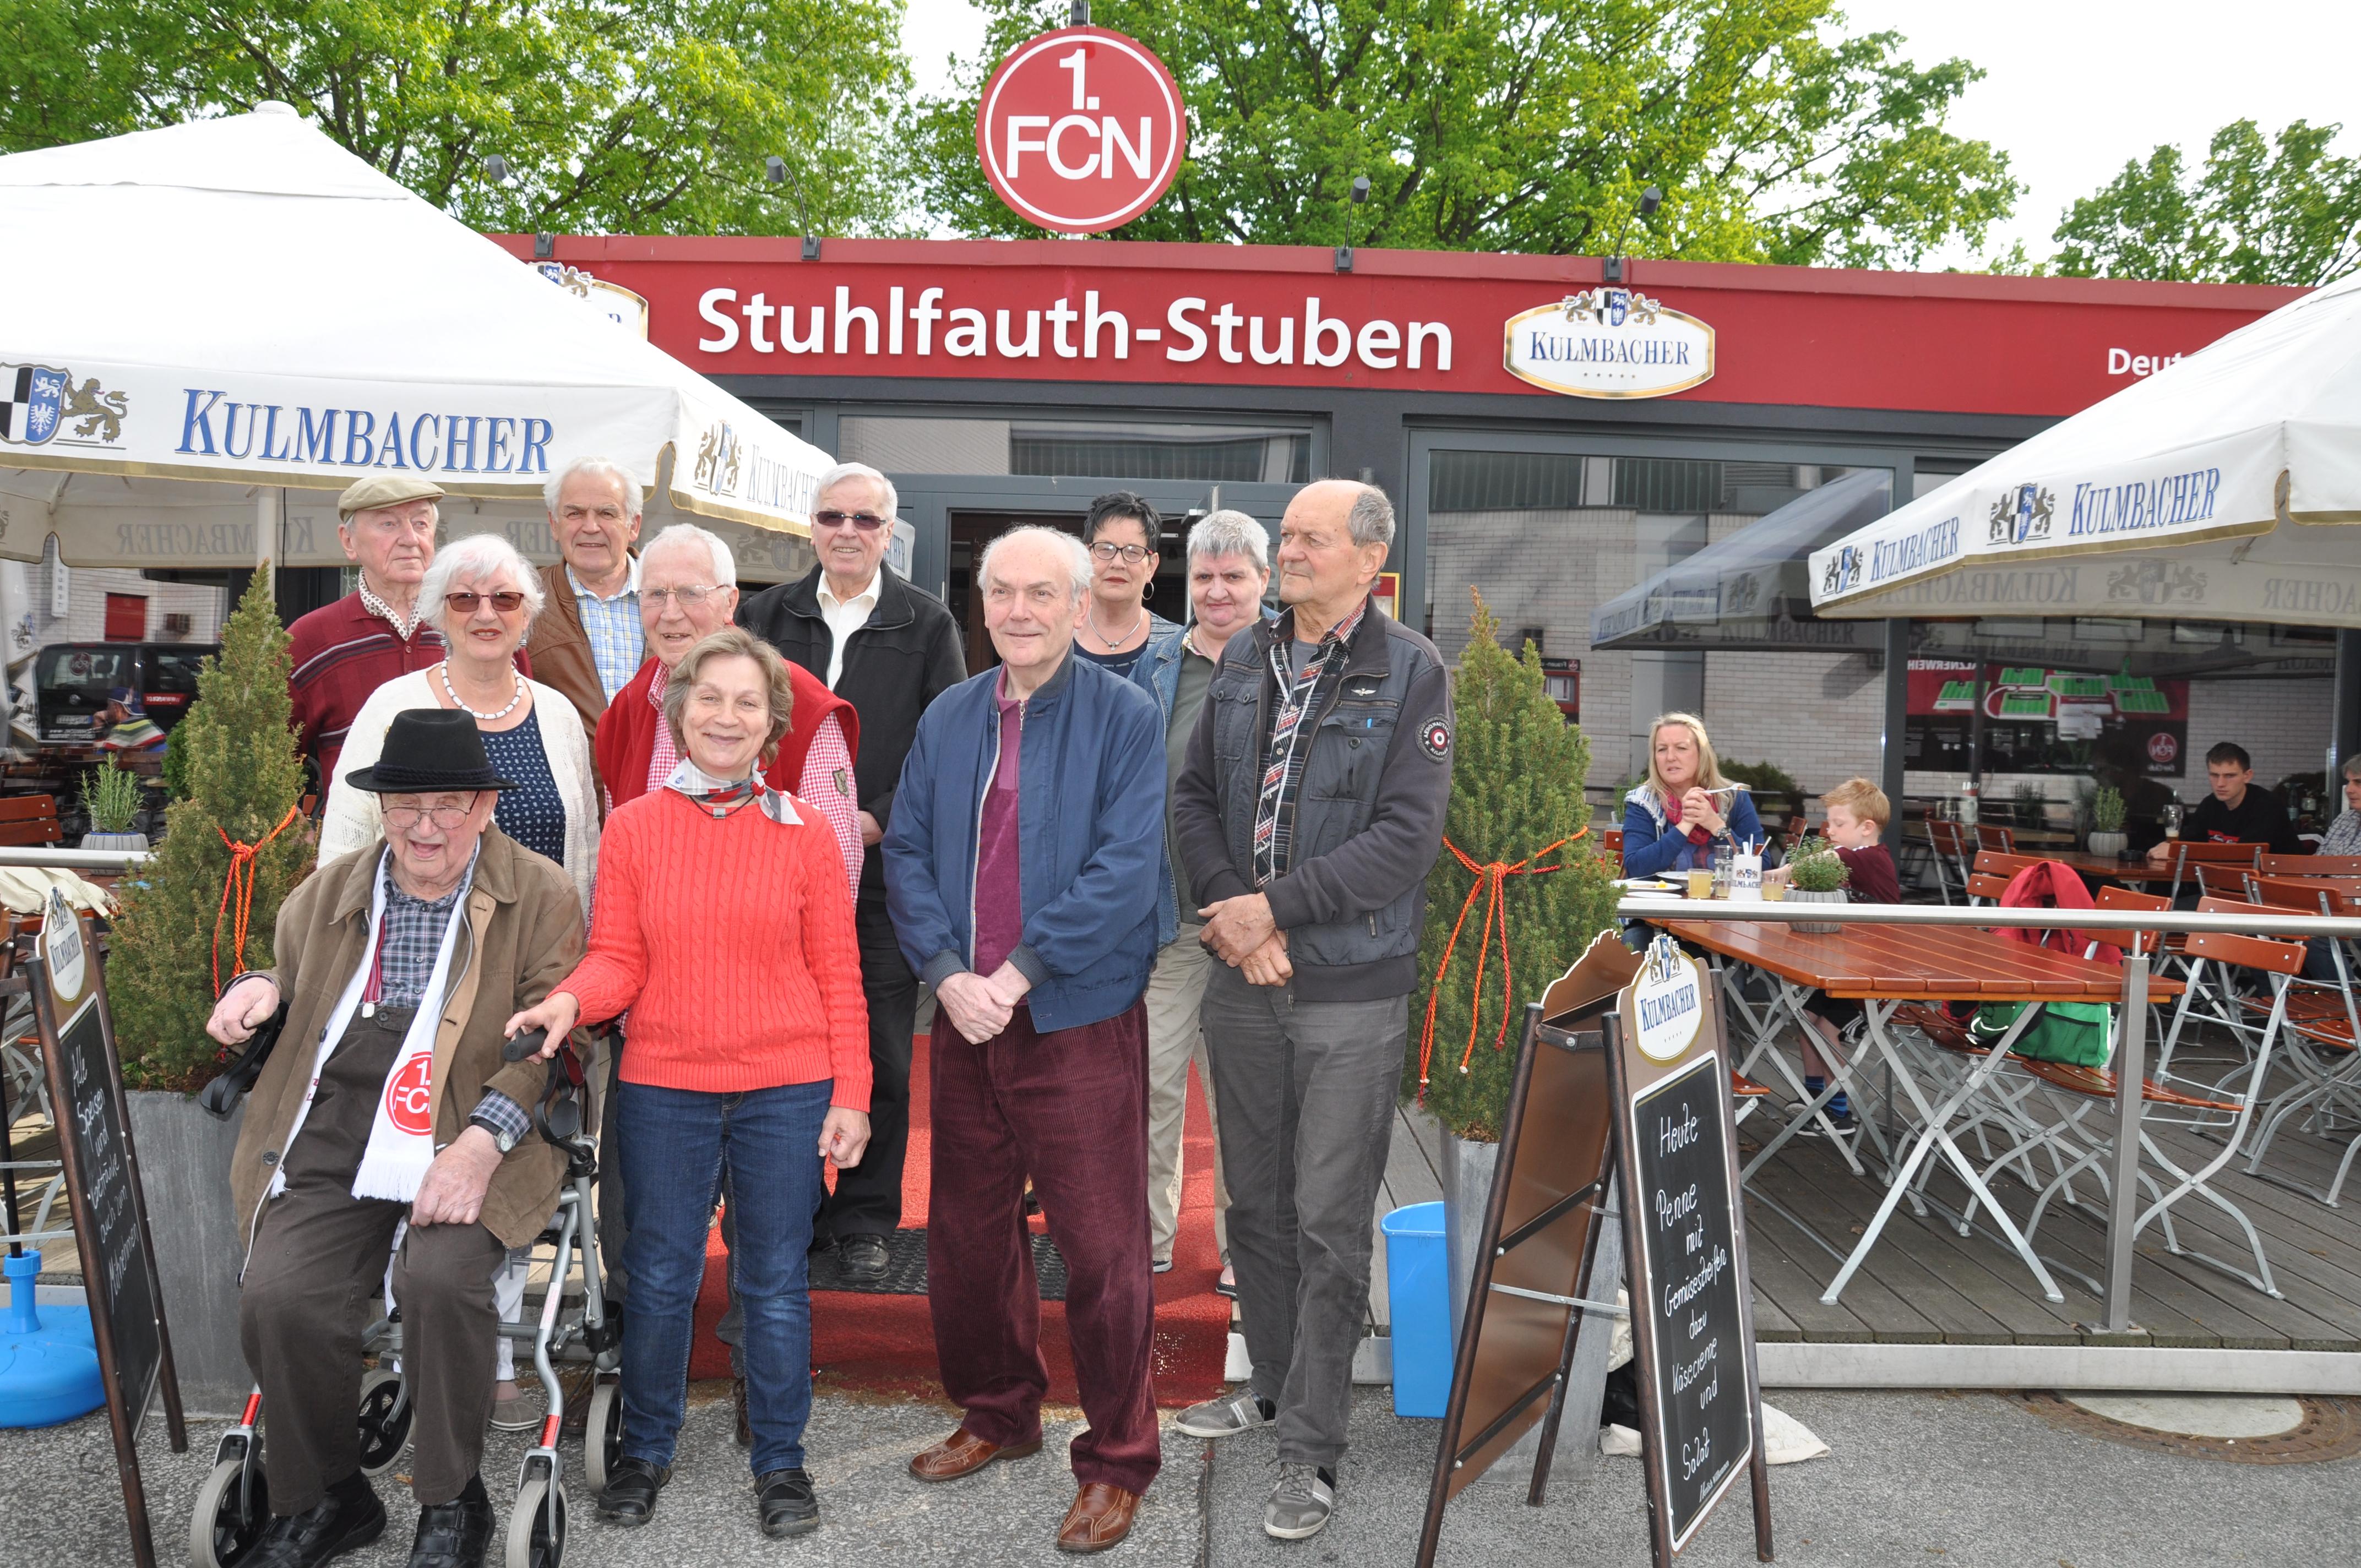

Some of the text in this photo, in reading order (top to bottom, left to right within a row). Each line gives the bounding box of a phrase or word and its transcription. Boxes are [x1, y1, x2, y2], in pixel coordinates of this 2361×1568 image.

[1058, 48, 1100, 111] 1.
[1005, 114, 1152, 181] FCN
[698, 285, 1452, 371] Stuhlfauth-Stuben
[1529, 331, 1690, 365] KULMBACHER
[174, 388, 553, 473] KULMBACHER
[747, 444, 820, 516] KULMBACHE
[2068, 468, 2220, 536] KULMBACHER
[1870, 516, 1959, 582] KULMBACHER
[1640, 983, 1696, 1032] KULMBACHER
[72, 1044, 88, 1097] Alle
[77, 1088, 106, 1152] Speisen
[394, 1086, 431, 1114] FC
[95, 1114, 110, 1157] und
[1661, 1103, 1698, 1157] Heute
[100, 1200, 116, 1244] auch
[1656, 1183, 1698, 1232] Penne
[1687, 1214, 1704, 1255] mit
[1689, 1309, 1707, 1340] dazu
[1700, 1365, 1717, 1409] und
[1683, 1427, 1710, 1481] Salat
